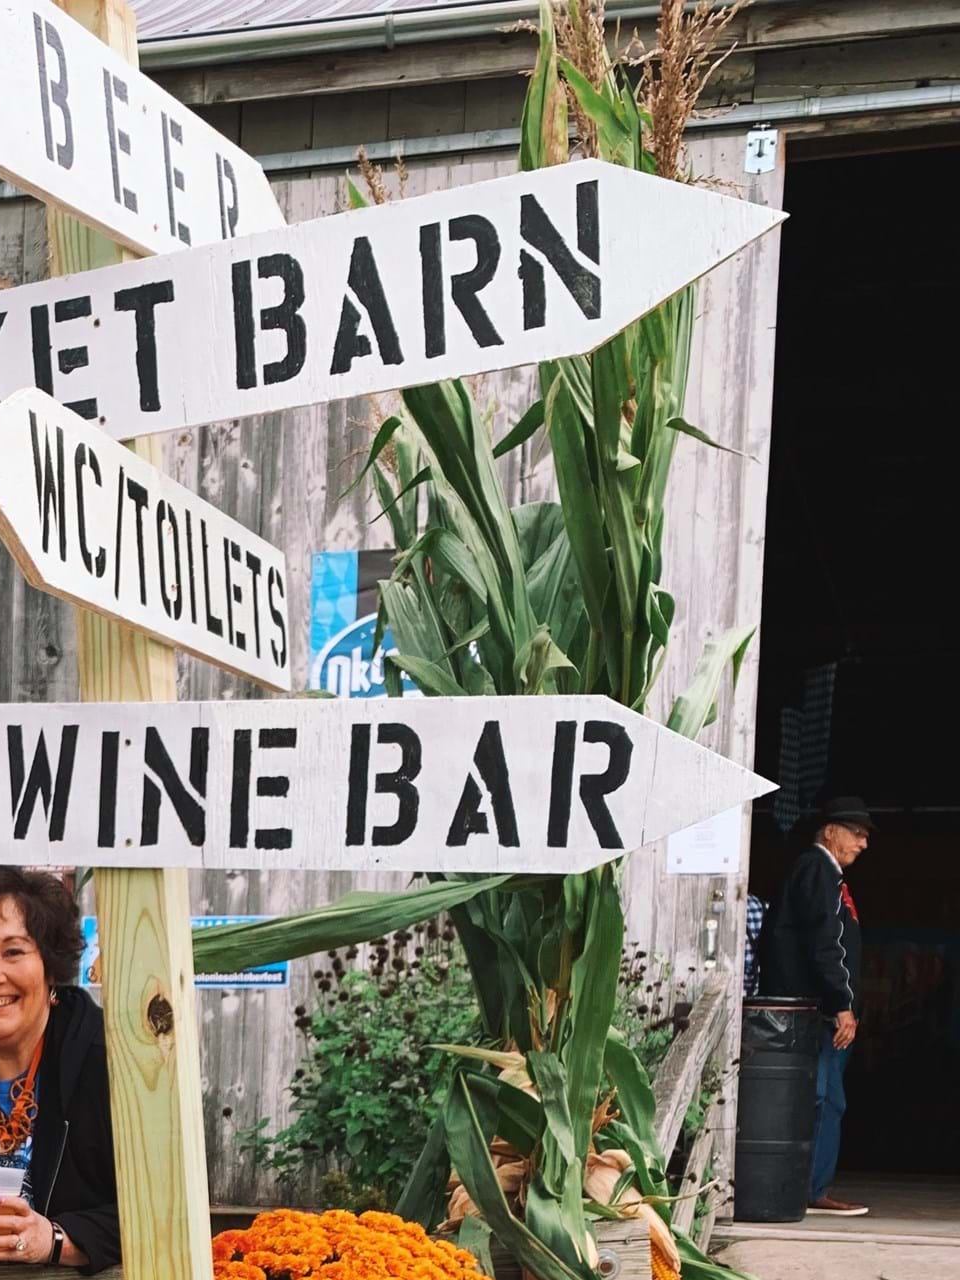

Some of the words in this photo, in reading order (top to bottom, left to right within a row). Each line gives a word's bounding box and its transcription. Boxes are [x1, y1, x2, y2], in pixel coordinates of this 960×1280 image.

[33, 12, 239, 247] BEER
[231, 179, 602, 390] BARN
[29, 410, 288, 669] WC/TOILETS
[345, 720, 635, 849] BAR
